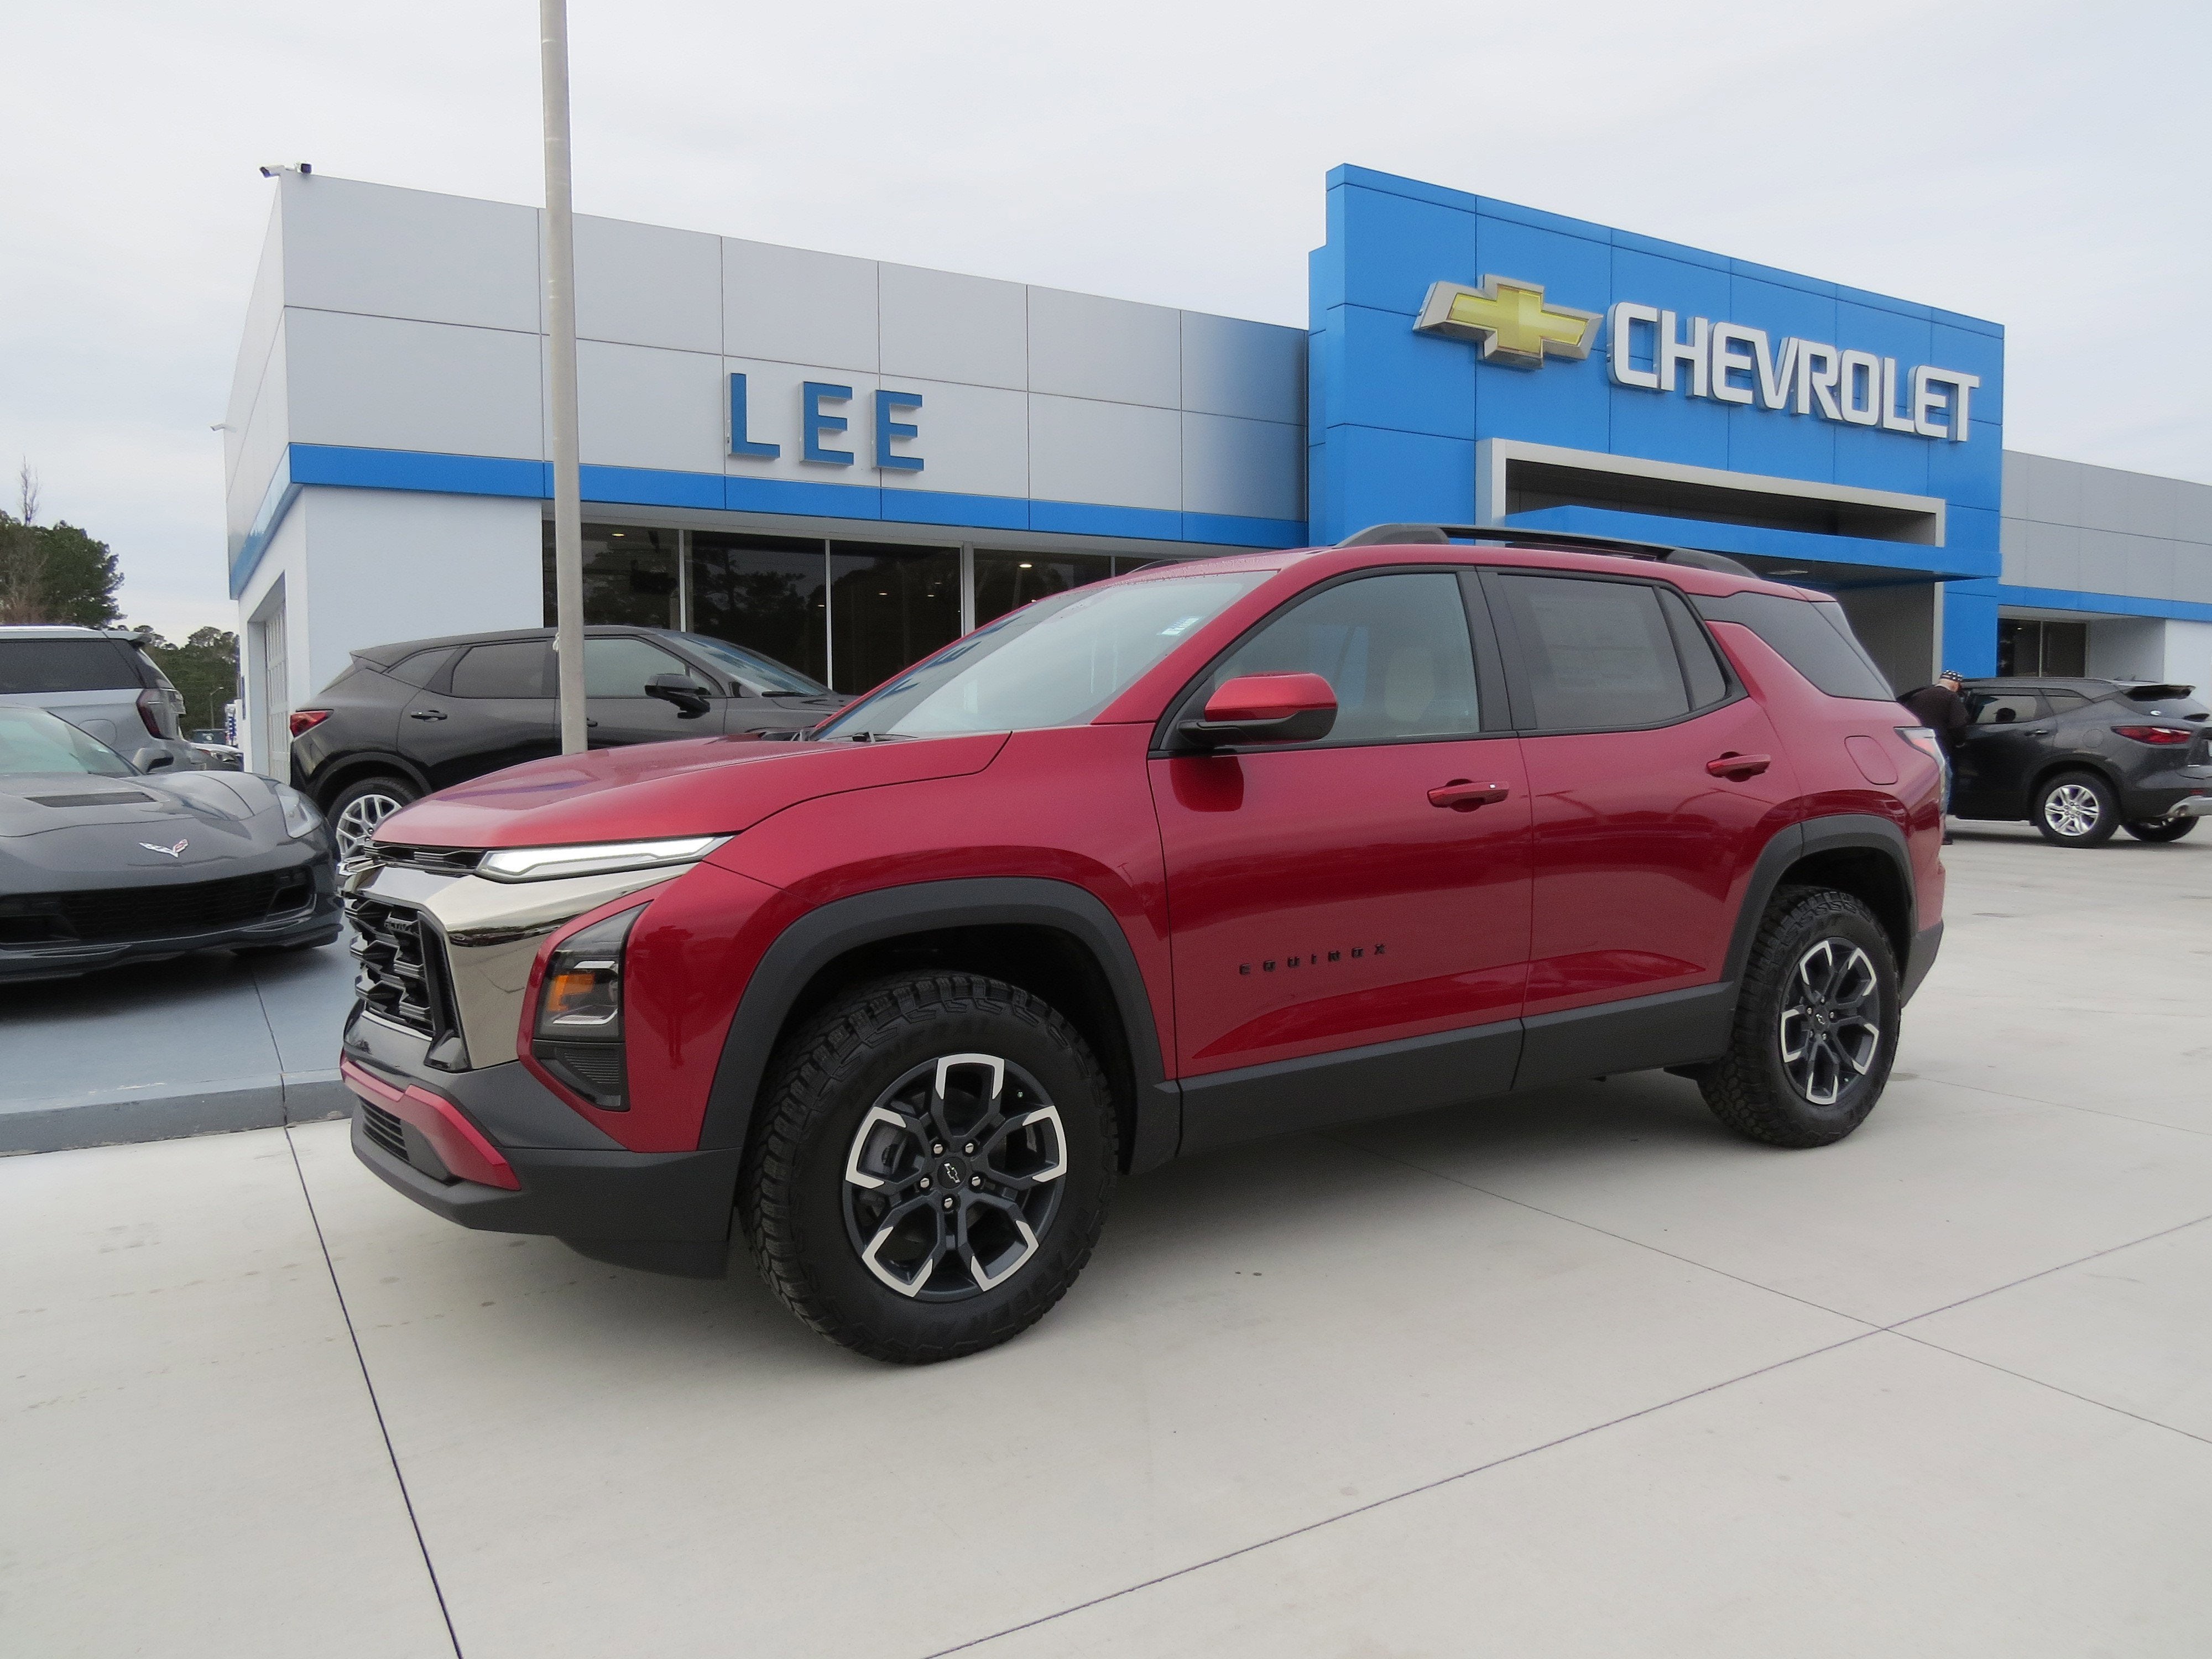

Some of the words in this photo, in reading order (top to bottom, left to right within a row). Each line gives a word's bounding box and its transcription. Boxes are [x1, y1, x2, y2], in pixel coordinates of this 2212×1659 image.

[1608, 302, 1980, 442] CHEVROLET
[728, 373, 925, 472] LEE
[1239, 943, 1385, 975] EQUINOX
